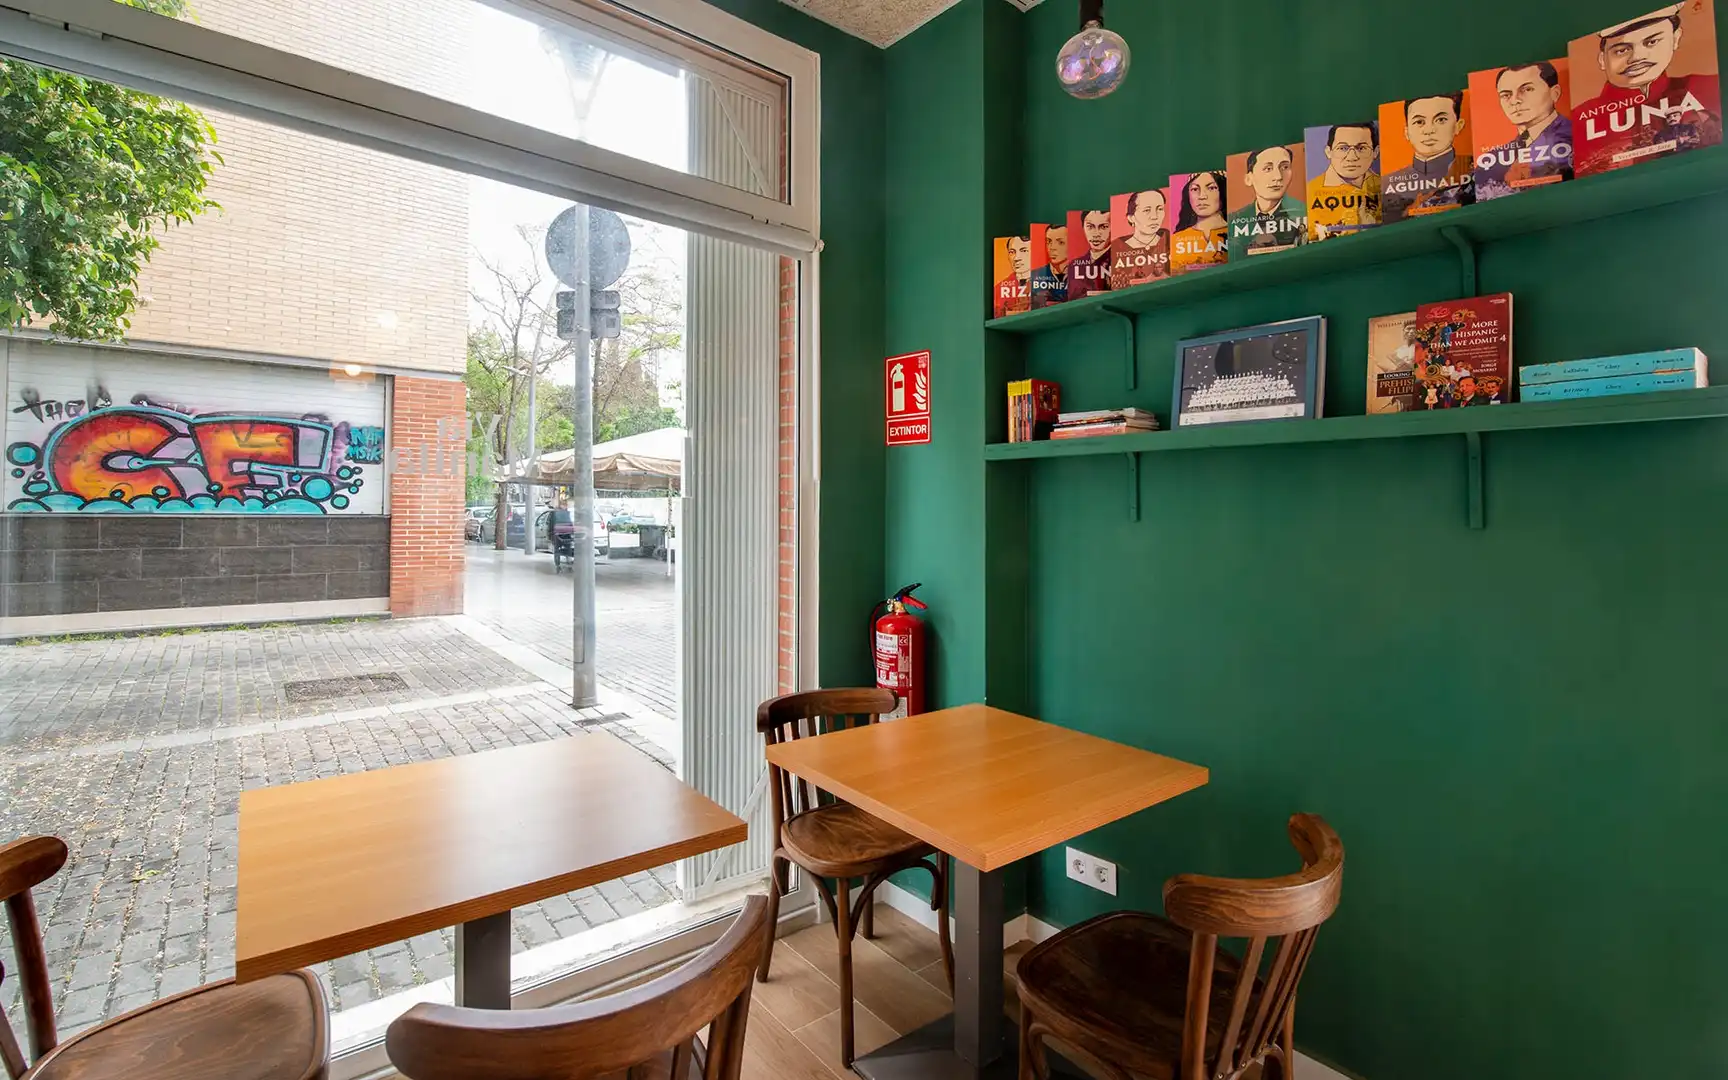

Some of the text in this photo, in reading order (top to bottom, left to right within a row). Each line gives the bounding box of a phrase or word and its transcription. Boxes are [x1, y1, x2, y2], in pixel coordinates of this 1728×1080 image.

[1578, 94, 1646, 121] ANTONIO
[1585, 91, 1705, 141] LUNA
[1481, 142, 1522, 153] MANUEL
[1476, 143, 1572, 170] QUEZO
[1385, 173, 1476, 195] AGUINALD
[1389, 173, 1419, 183] EMILIO
[1311, 194, 1379, 211] AQUIN
[1231, 214, 1275, 225] APOLINARIO
[1116, 249, 1145, 257] TEODORA
[1175, 239, 1228, 254] SILAN
[1115, 252, 1171, 269] ALONS
[1074, 265, 1111, 280] LUN
[1000, 285, 1031, 299] RIZ
[1471, 319, 1498, 329] MORE
[1456, 328, 1498, 338] HISPANIC
[1430, 334, 1506, 349] THAN WE ADMIT 4
[1379, 378, 1414, 388] PREHIS
[889, 424, 927, 437] EXTINTOR
